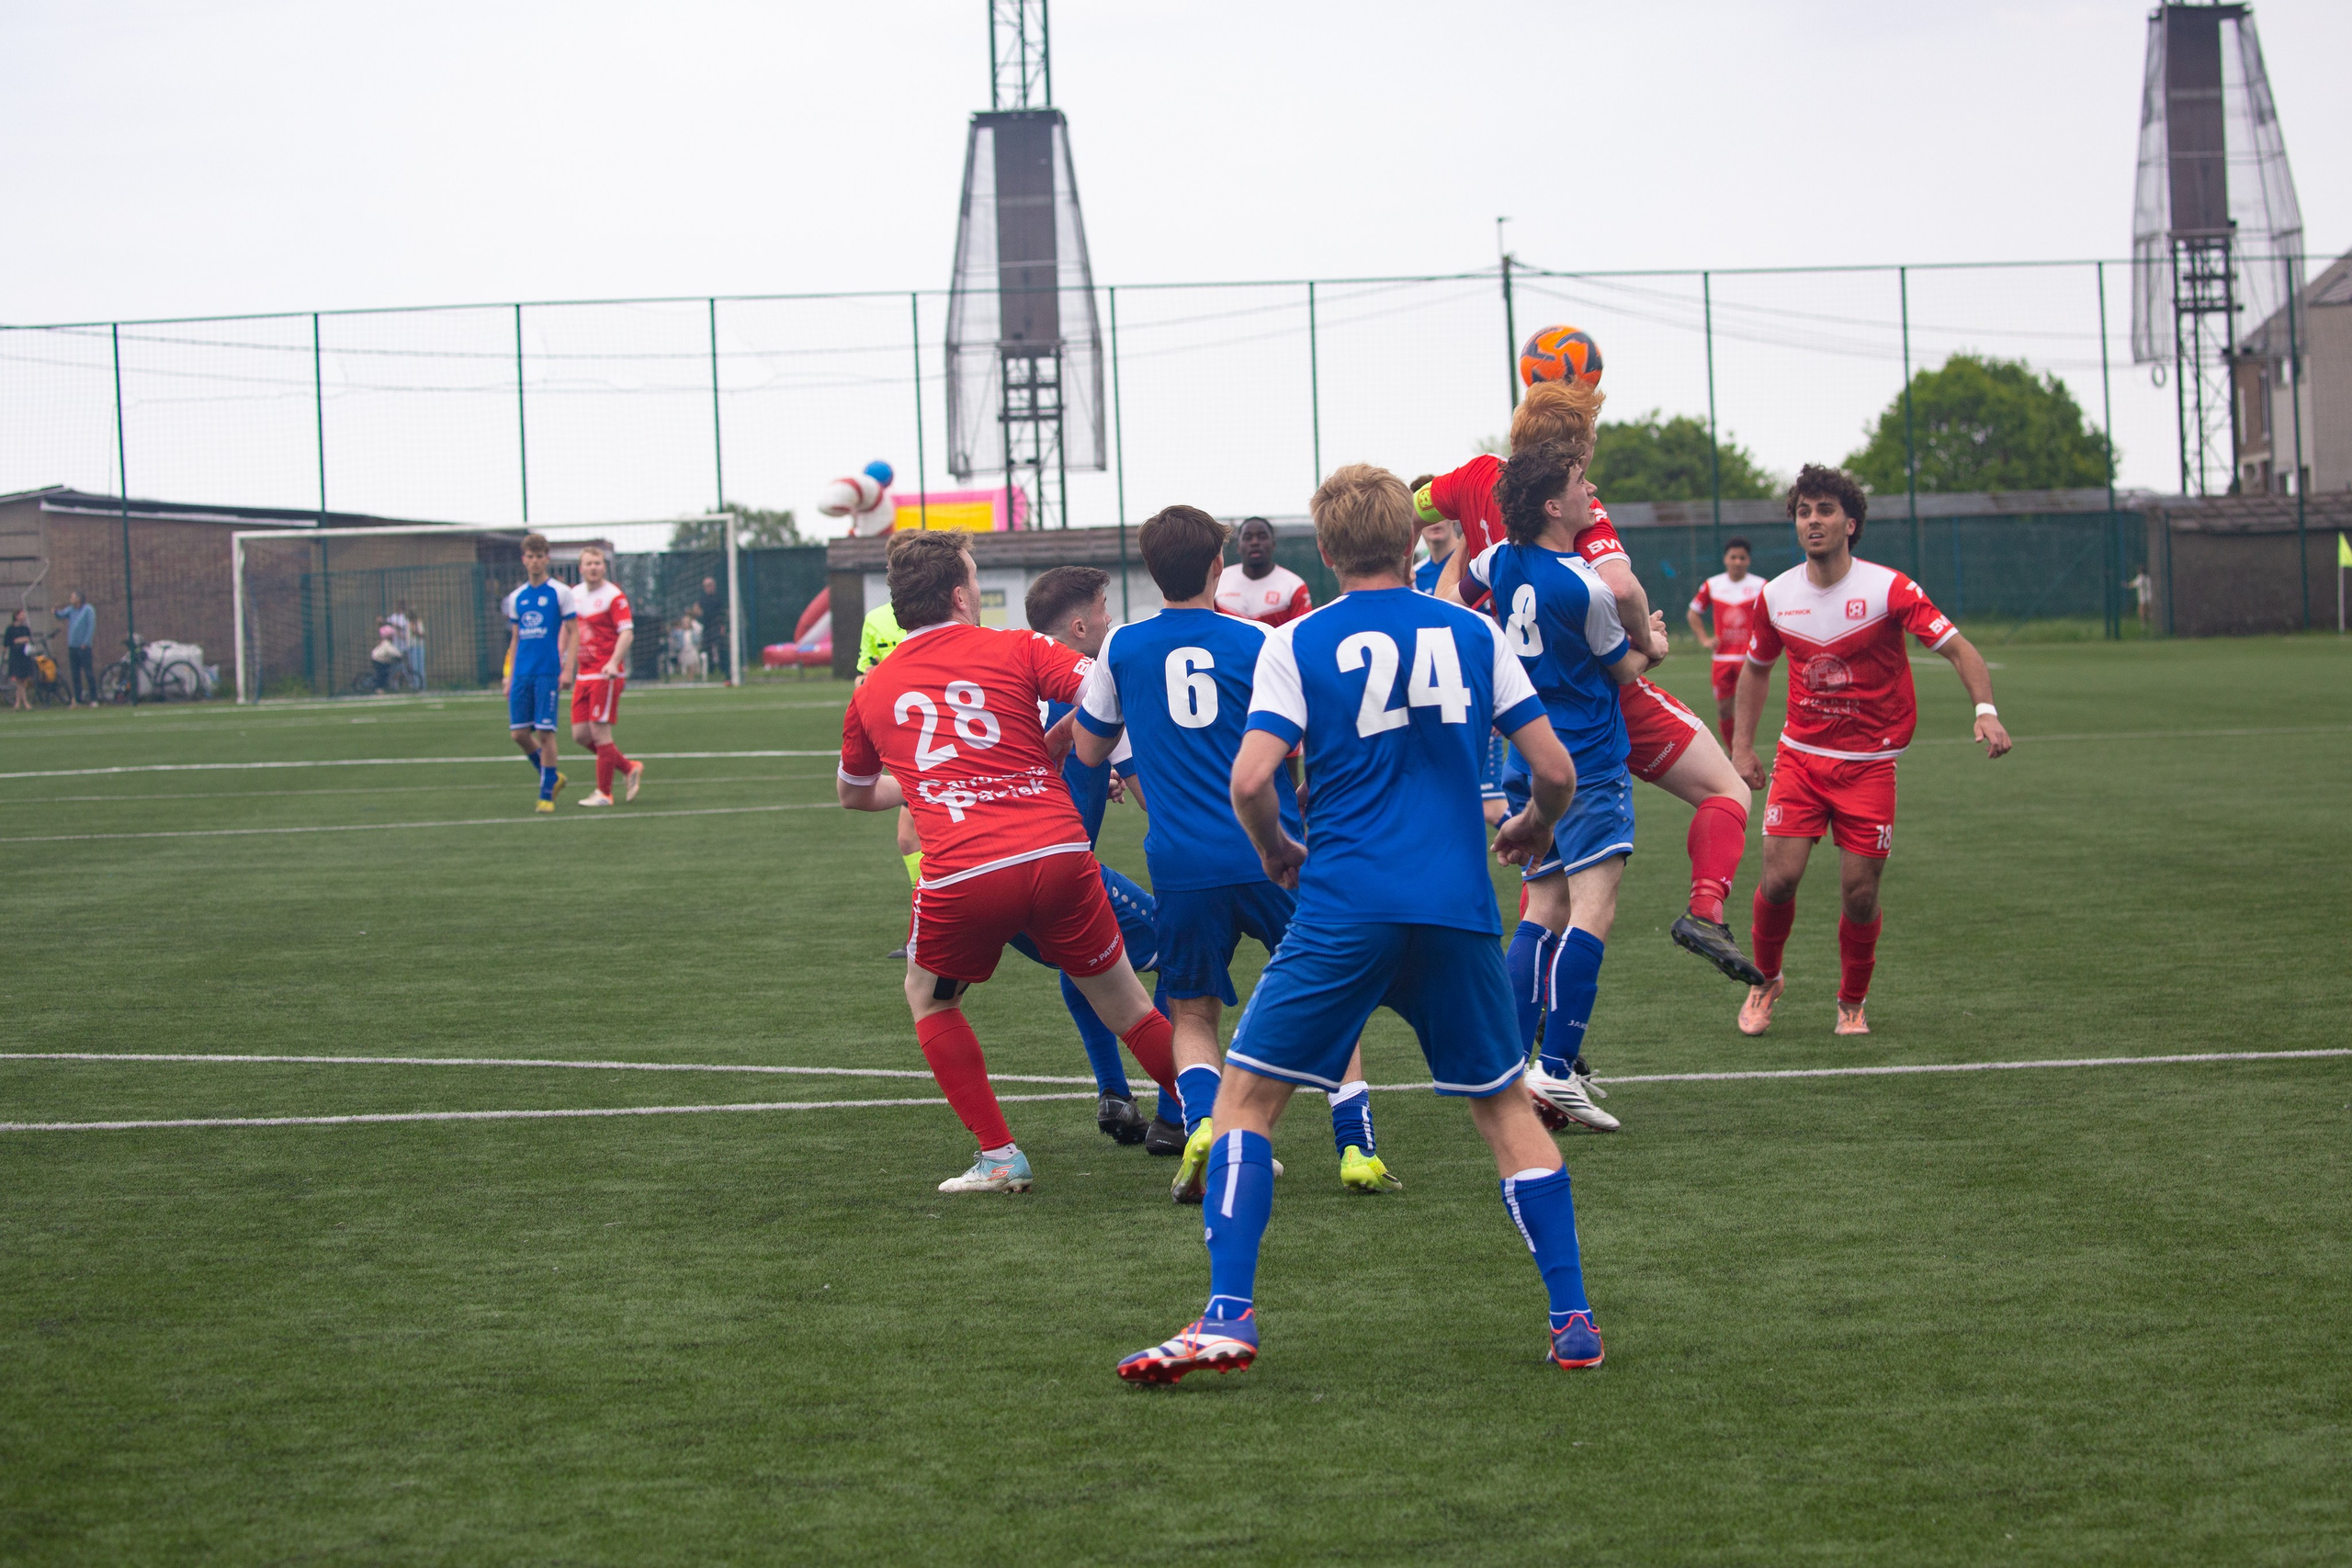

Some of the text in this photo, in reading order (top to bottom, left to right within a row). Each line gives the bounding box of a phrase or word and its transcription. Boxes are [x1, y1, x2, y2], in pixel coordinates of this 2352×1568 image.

[1505, 583, 1544, 658] 8
[1164, 647, 1219, 728] 6
[1335, 626, 1472, 739] 24
[893, 680, 1001, 772] 28
[1647, 740, 1676, 771] PATRICK
[1876, 824, 1893, 850] 18
[1098, 931, 1120, 961] PATRICK
